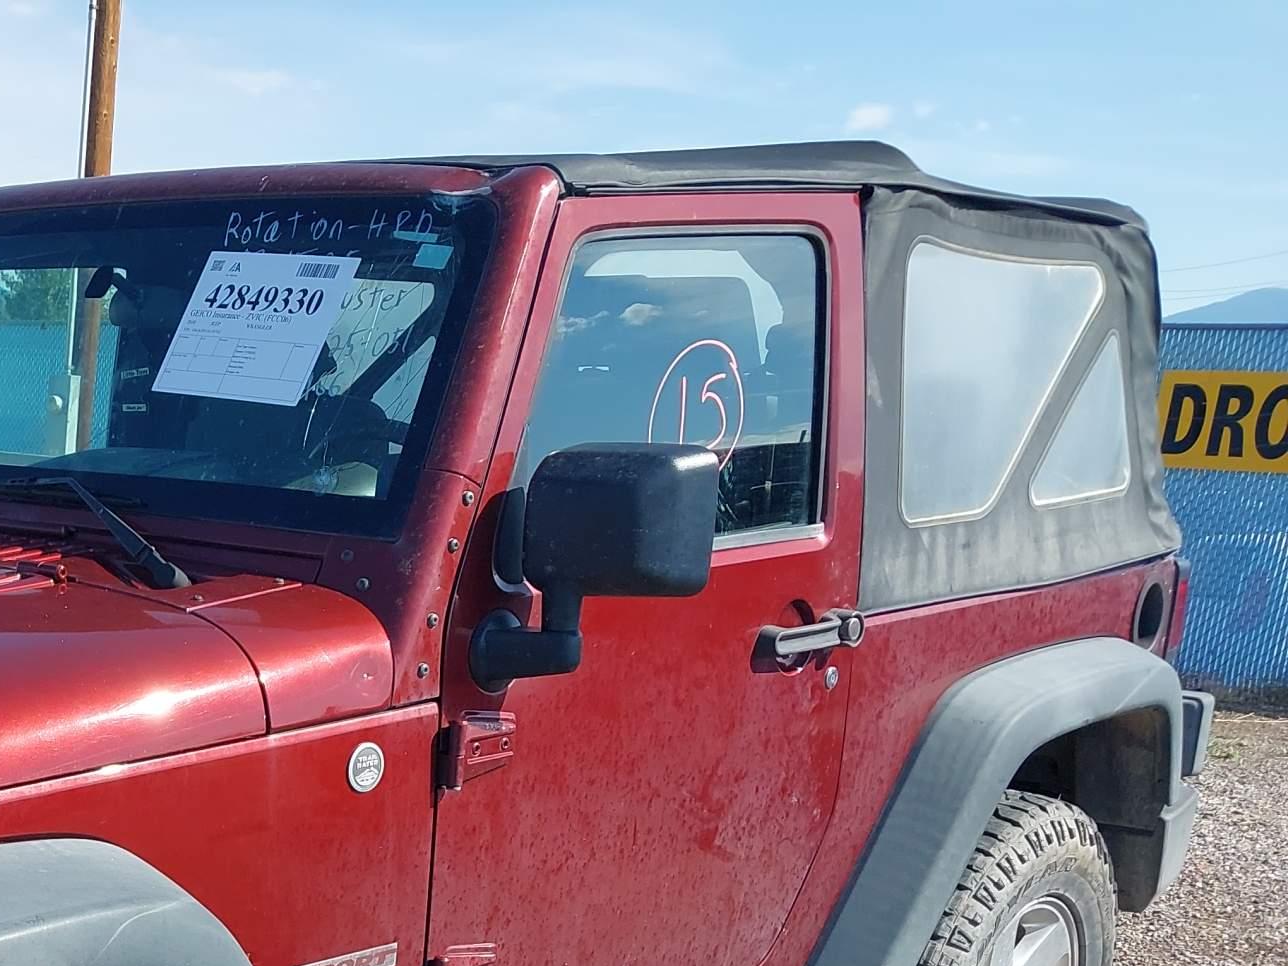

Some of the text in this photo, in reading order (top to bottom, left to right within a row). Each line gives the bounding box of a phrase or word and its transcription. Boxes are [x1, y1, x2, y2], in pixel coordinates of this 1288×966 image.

[190, 309, 213, 318] GEICO
[212, 311, 241, 320] Insurance
[204, 284, 324, 316] 42849330
[678, 372, 727, 449] 15
[1160, 383, 1288, 460] DRO
